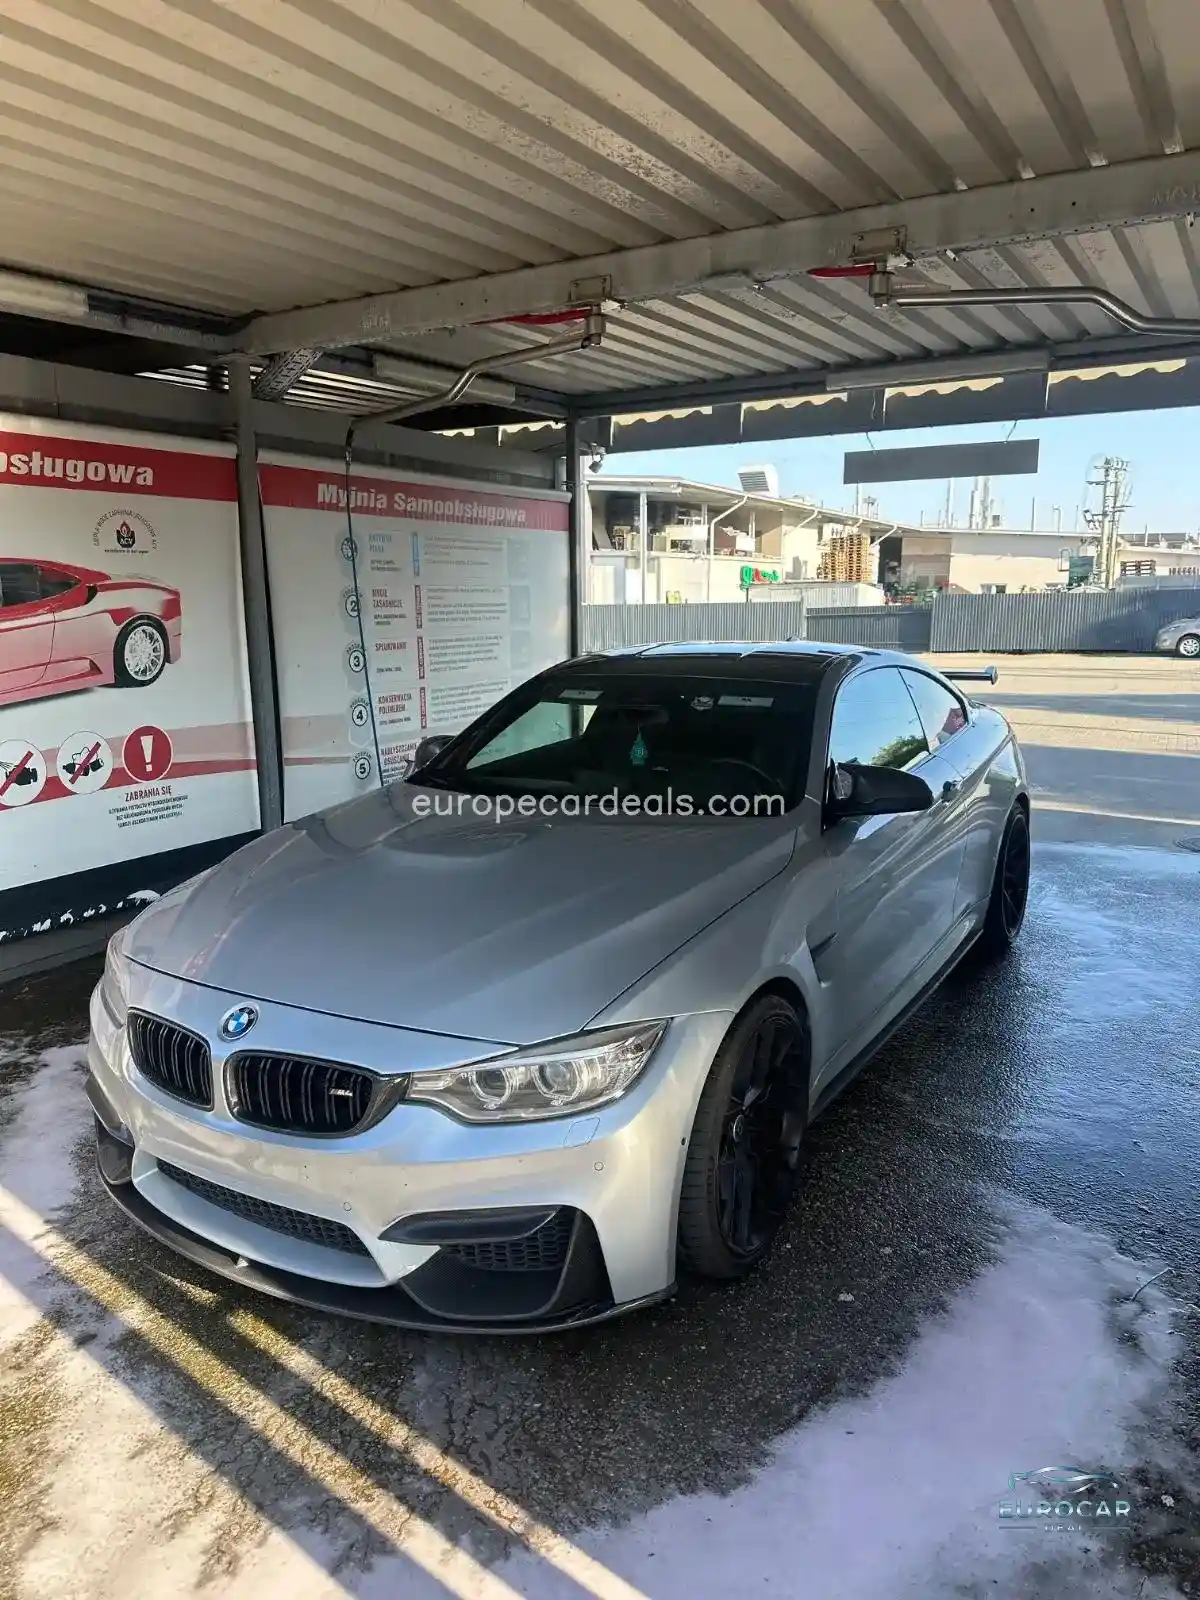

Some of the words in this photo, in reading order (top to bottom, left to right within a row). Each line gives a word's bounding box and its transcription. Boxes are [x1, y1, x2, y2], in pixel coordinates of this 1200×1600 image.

[317, 483, 387, 510] Myjnia
[394, 492, 526, 523] Samoobsługowa
[350, 600, 358, 612] 2
[353, 655, 361, 667] 3
[356, 709, 364, 721] 4
[359, 763, 367, 774] 5
[125, 787, 160, 802] ZABRANIA
[161, 784, 172, 797] SIĘ
